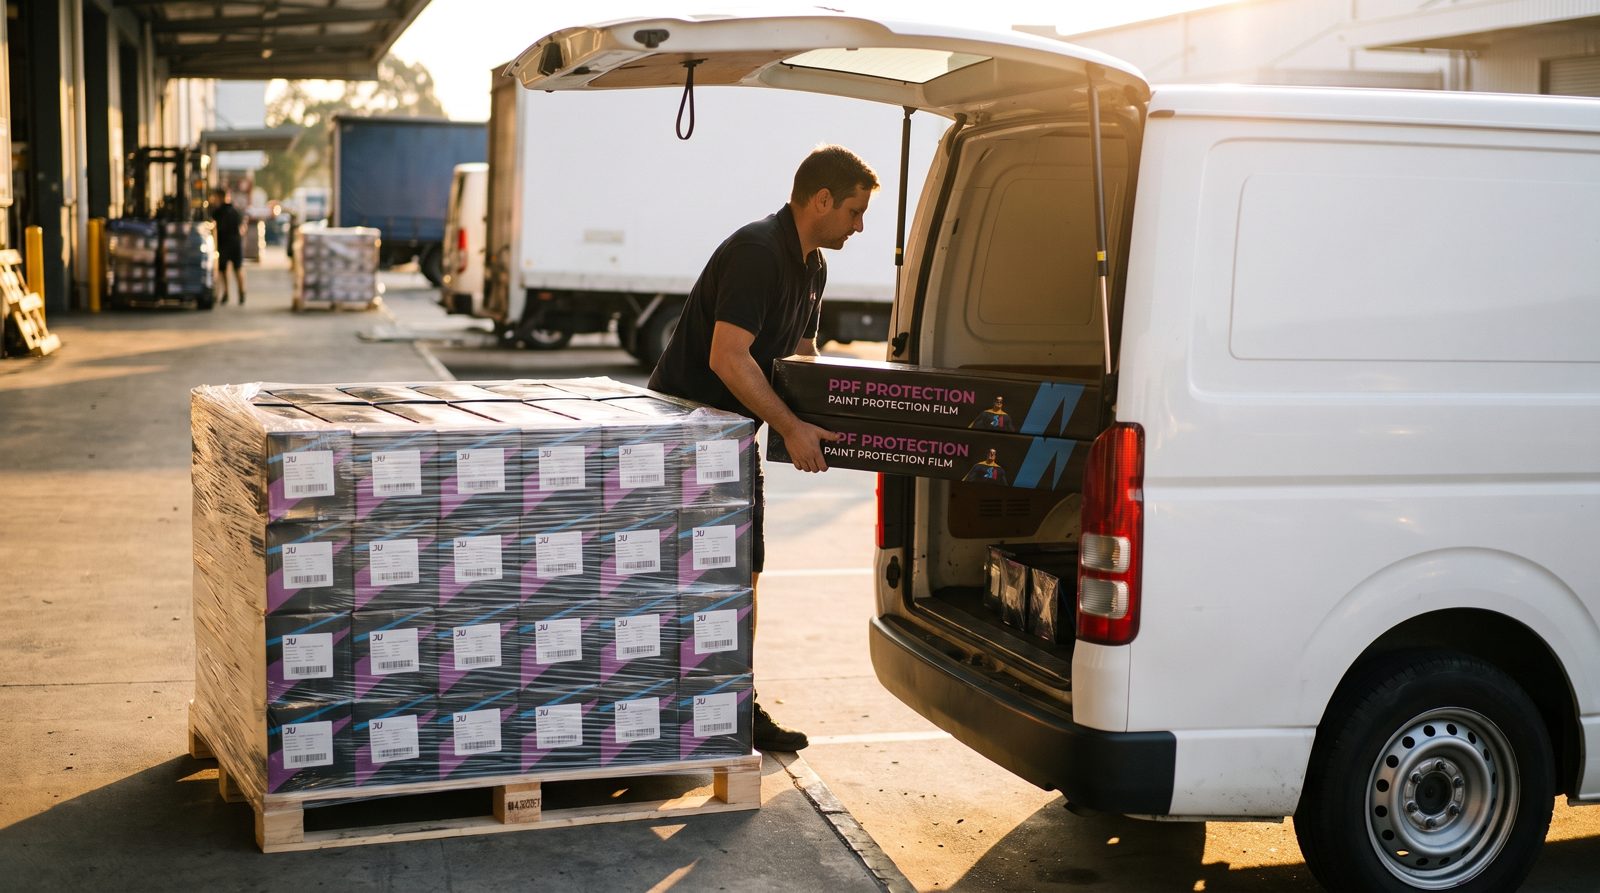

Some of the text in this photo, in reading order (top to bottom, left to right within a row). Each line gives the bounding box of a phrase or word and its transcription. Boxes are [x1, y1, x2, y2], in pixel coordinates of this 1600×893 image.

[829, 379, 976, 404] PPF PROTECTION
[828, 395, 958, 415] PAINT PROTECTION FILM
[825, 431, 969, 457] PF PROTECTION
[824, 446, 953, 468] PAINT PROTECTION FILM
